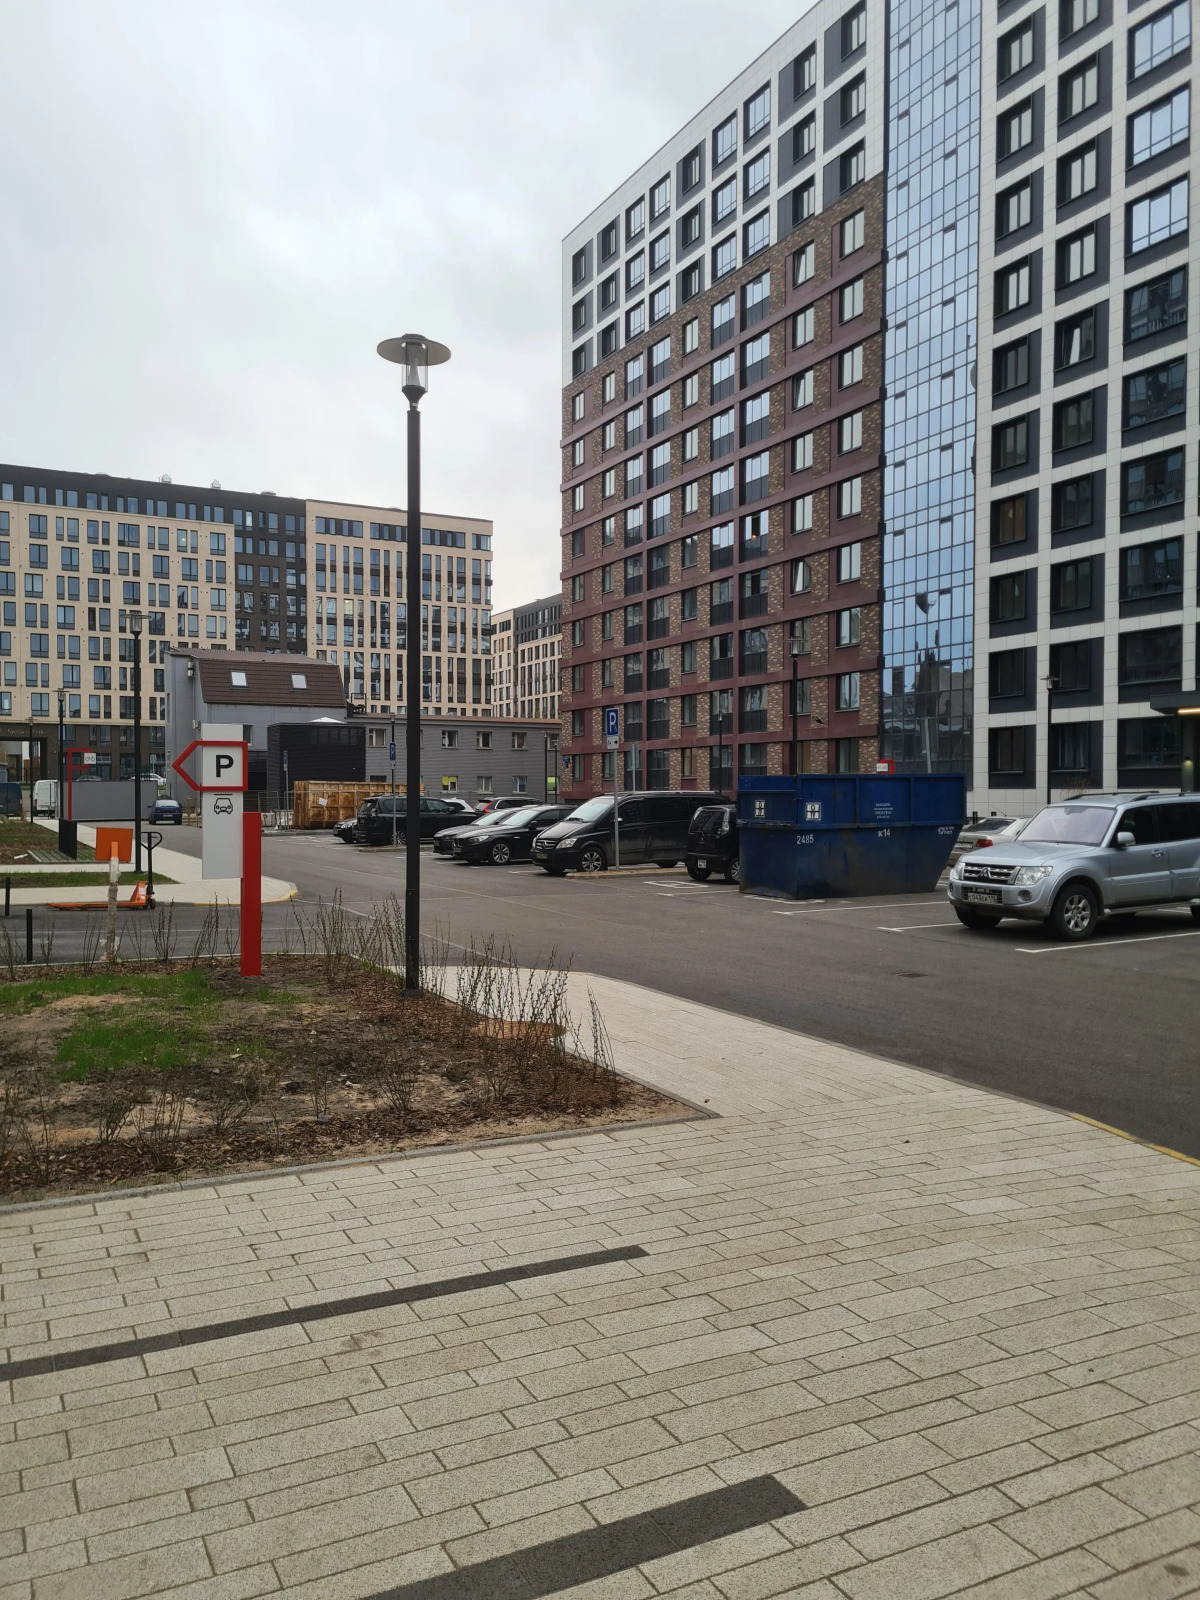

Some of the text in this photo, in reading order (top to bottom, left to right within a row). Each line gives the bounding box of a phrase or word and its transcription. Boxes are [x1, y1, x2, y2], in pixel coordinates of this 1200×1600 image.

[609, 712, 617, 733] P
[215, 754, 234, 778] P
[796, 834, 814, 845] 2485
